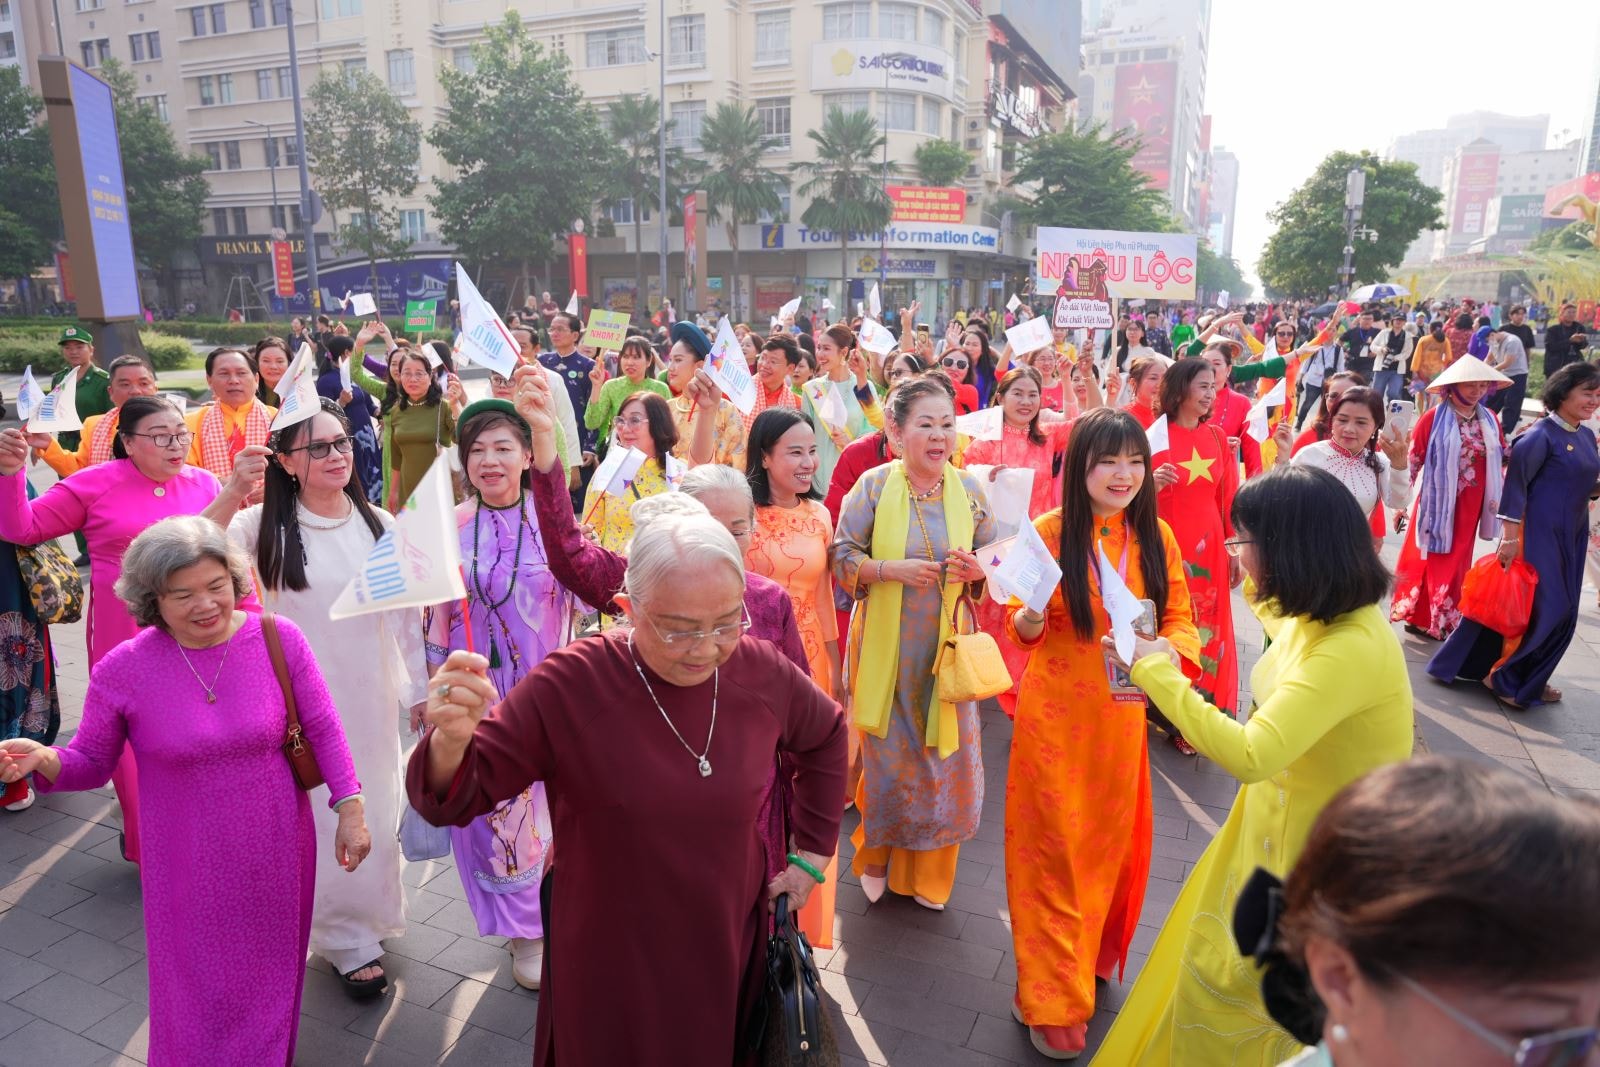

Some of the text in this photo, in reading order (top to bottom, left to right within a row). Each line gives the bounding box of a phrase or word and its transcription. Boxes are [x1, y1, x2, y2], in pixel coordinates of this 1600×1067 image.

[798, 229, 866, 243] Tourst
[872, 228, 969, 245] Information
[972, 231, 995, 246] Center
[216, 240, 306, 254] FRANCK MLE
[879, 259, 936, 269] SGONTOURIST
[1134, 250, 1193, 290] LỘC
[1092, 304, 1107, 312] Nam
[1094, 316, 1111, 324] Nam
